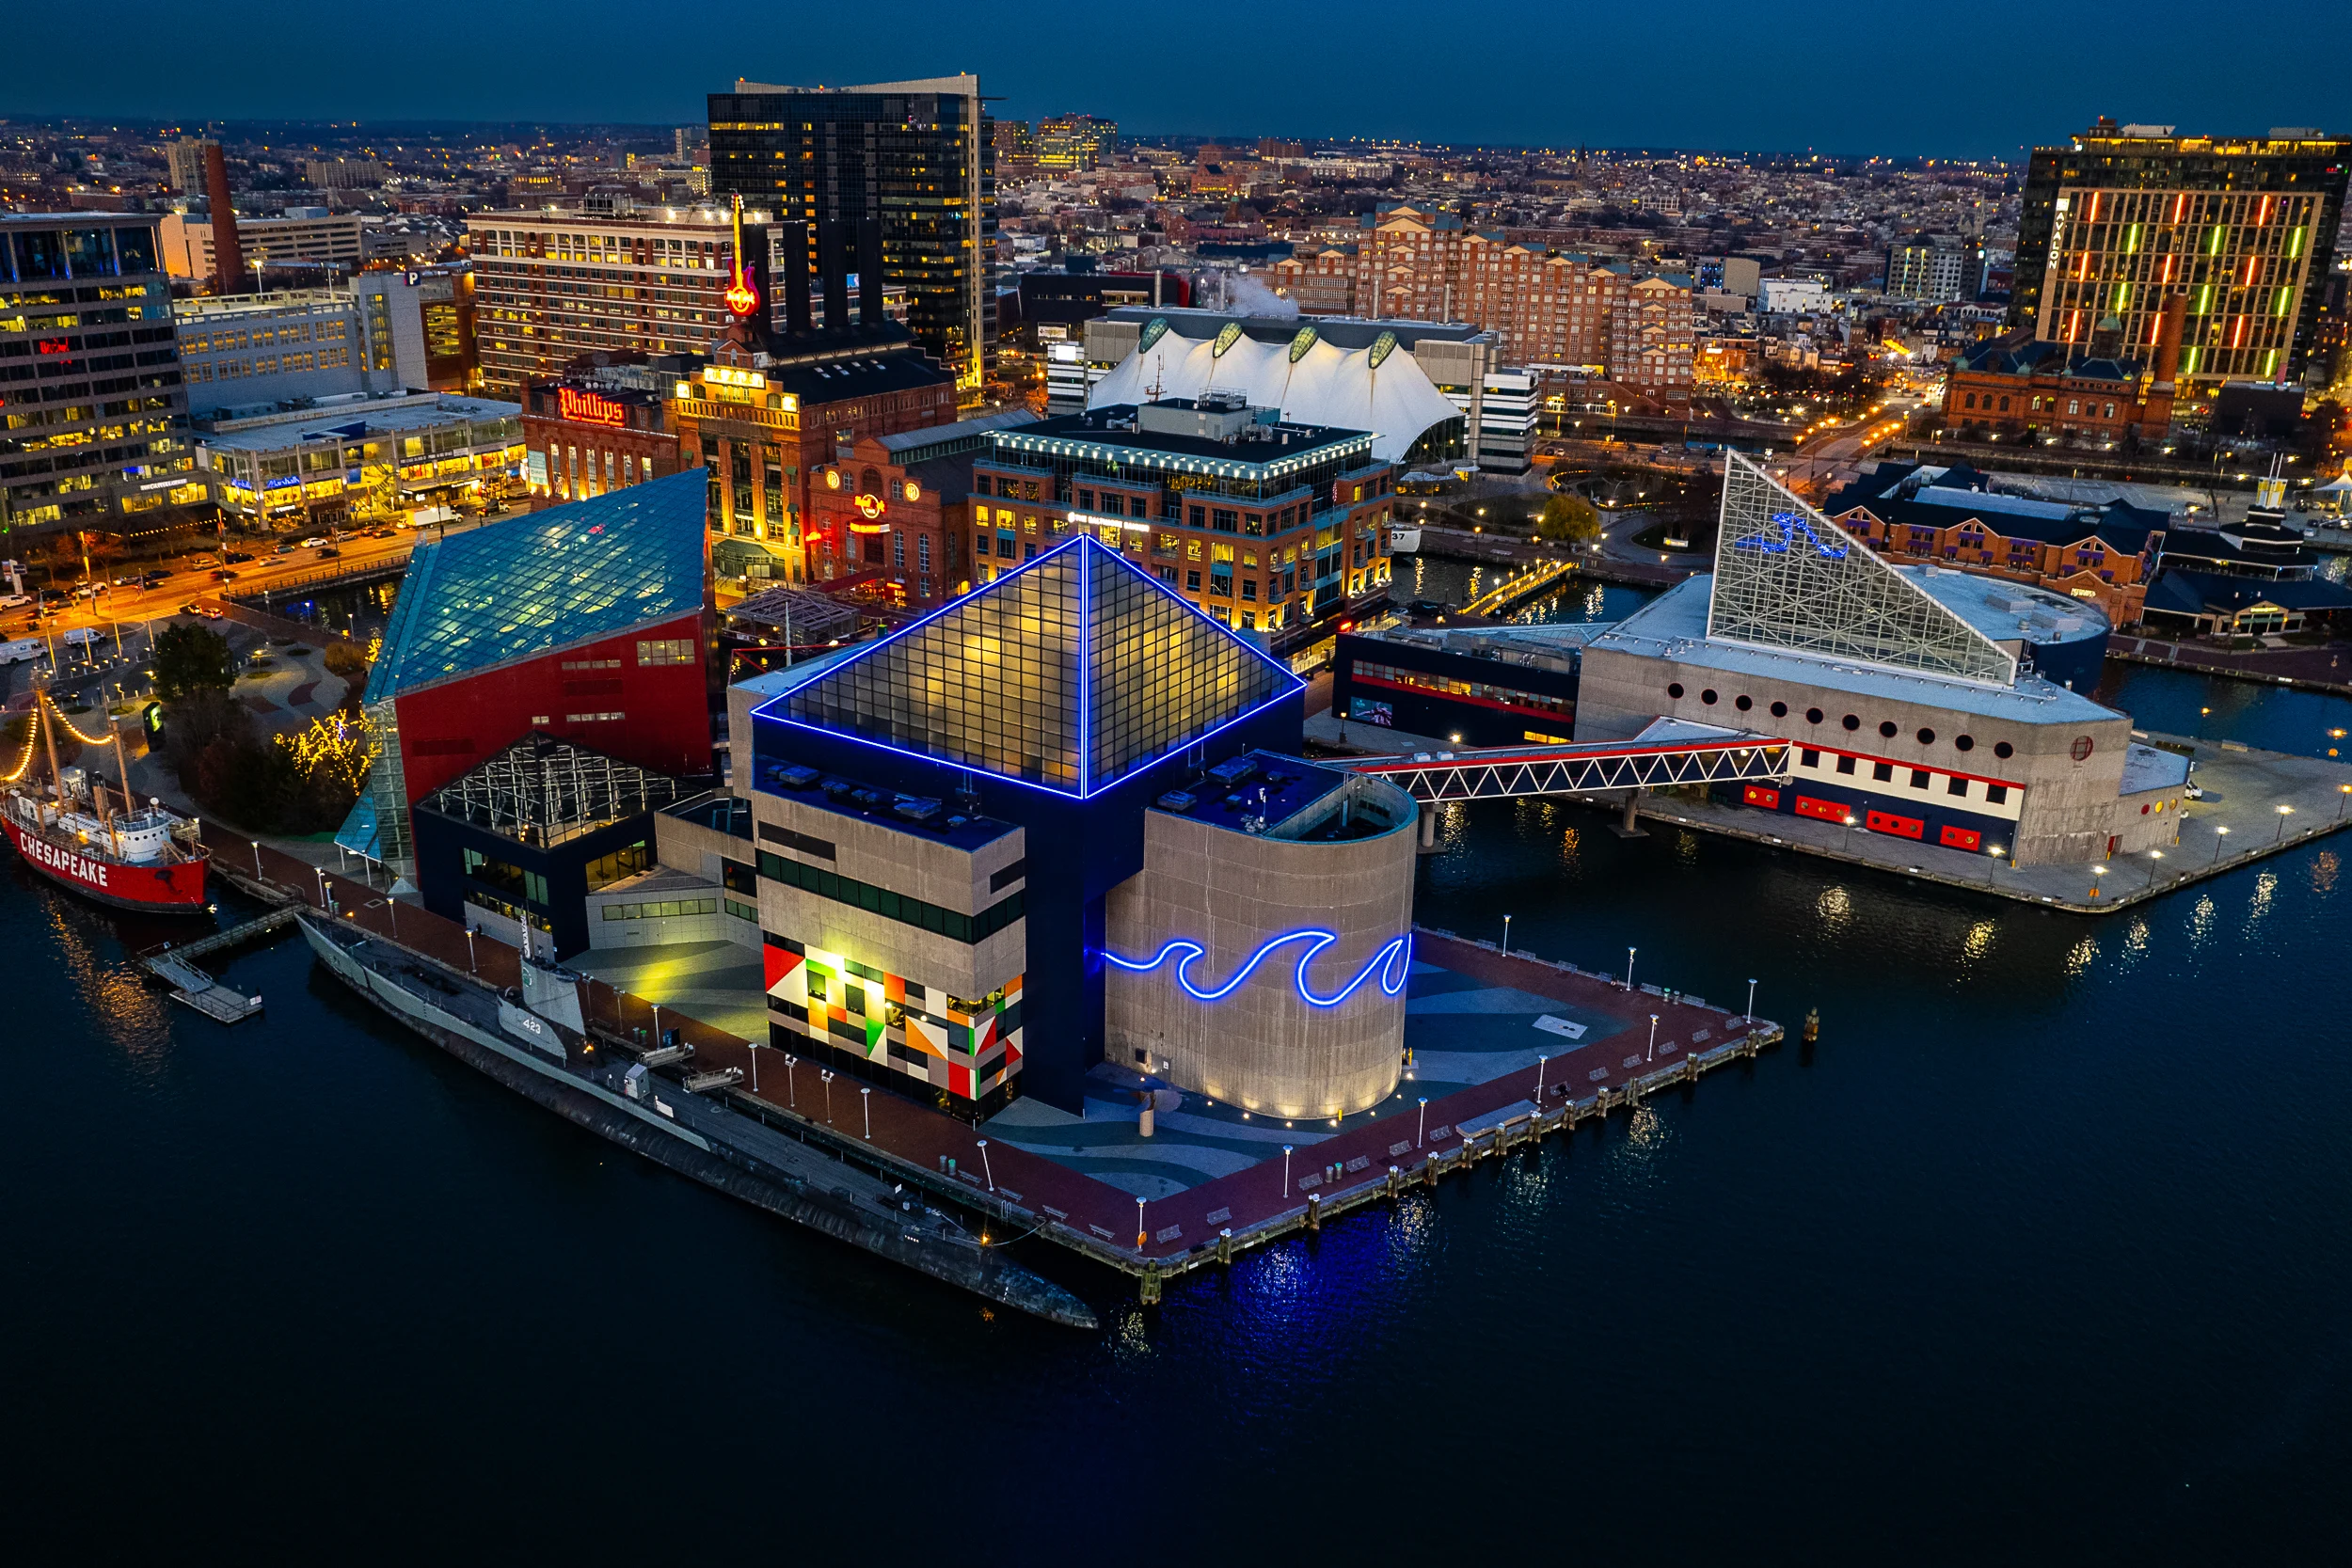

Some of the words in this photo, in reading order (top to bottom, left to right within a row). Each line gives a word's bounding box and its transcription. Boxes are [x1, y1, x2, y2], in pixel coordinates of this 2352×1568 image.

[2048, 212, 2065, 270] AVALON
[409, 272, 419, 285] P
[558, 387, 625, 424] Phillips
[1391, 532, 1406, 541] 37
[20, 832, 108, 887] CHESAPEAKE
[523, 1019, 542, 1035] 423
